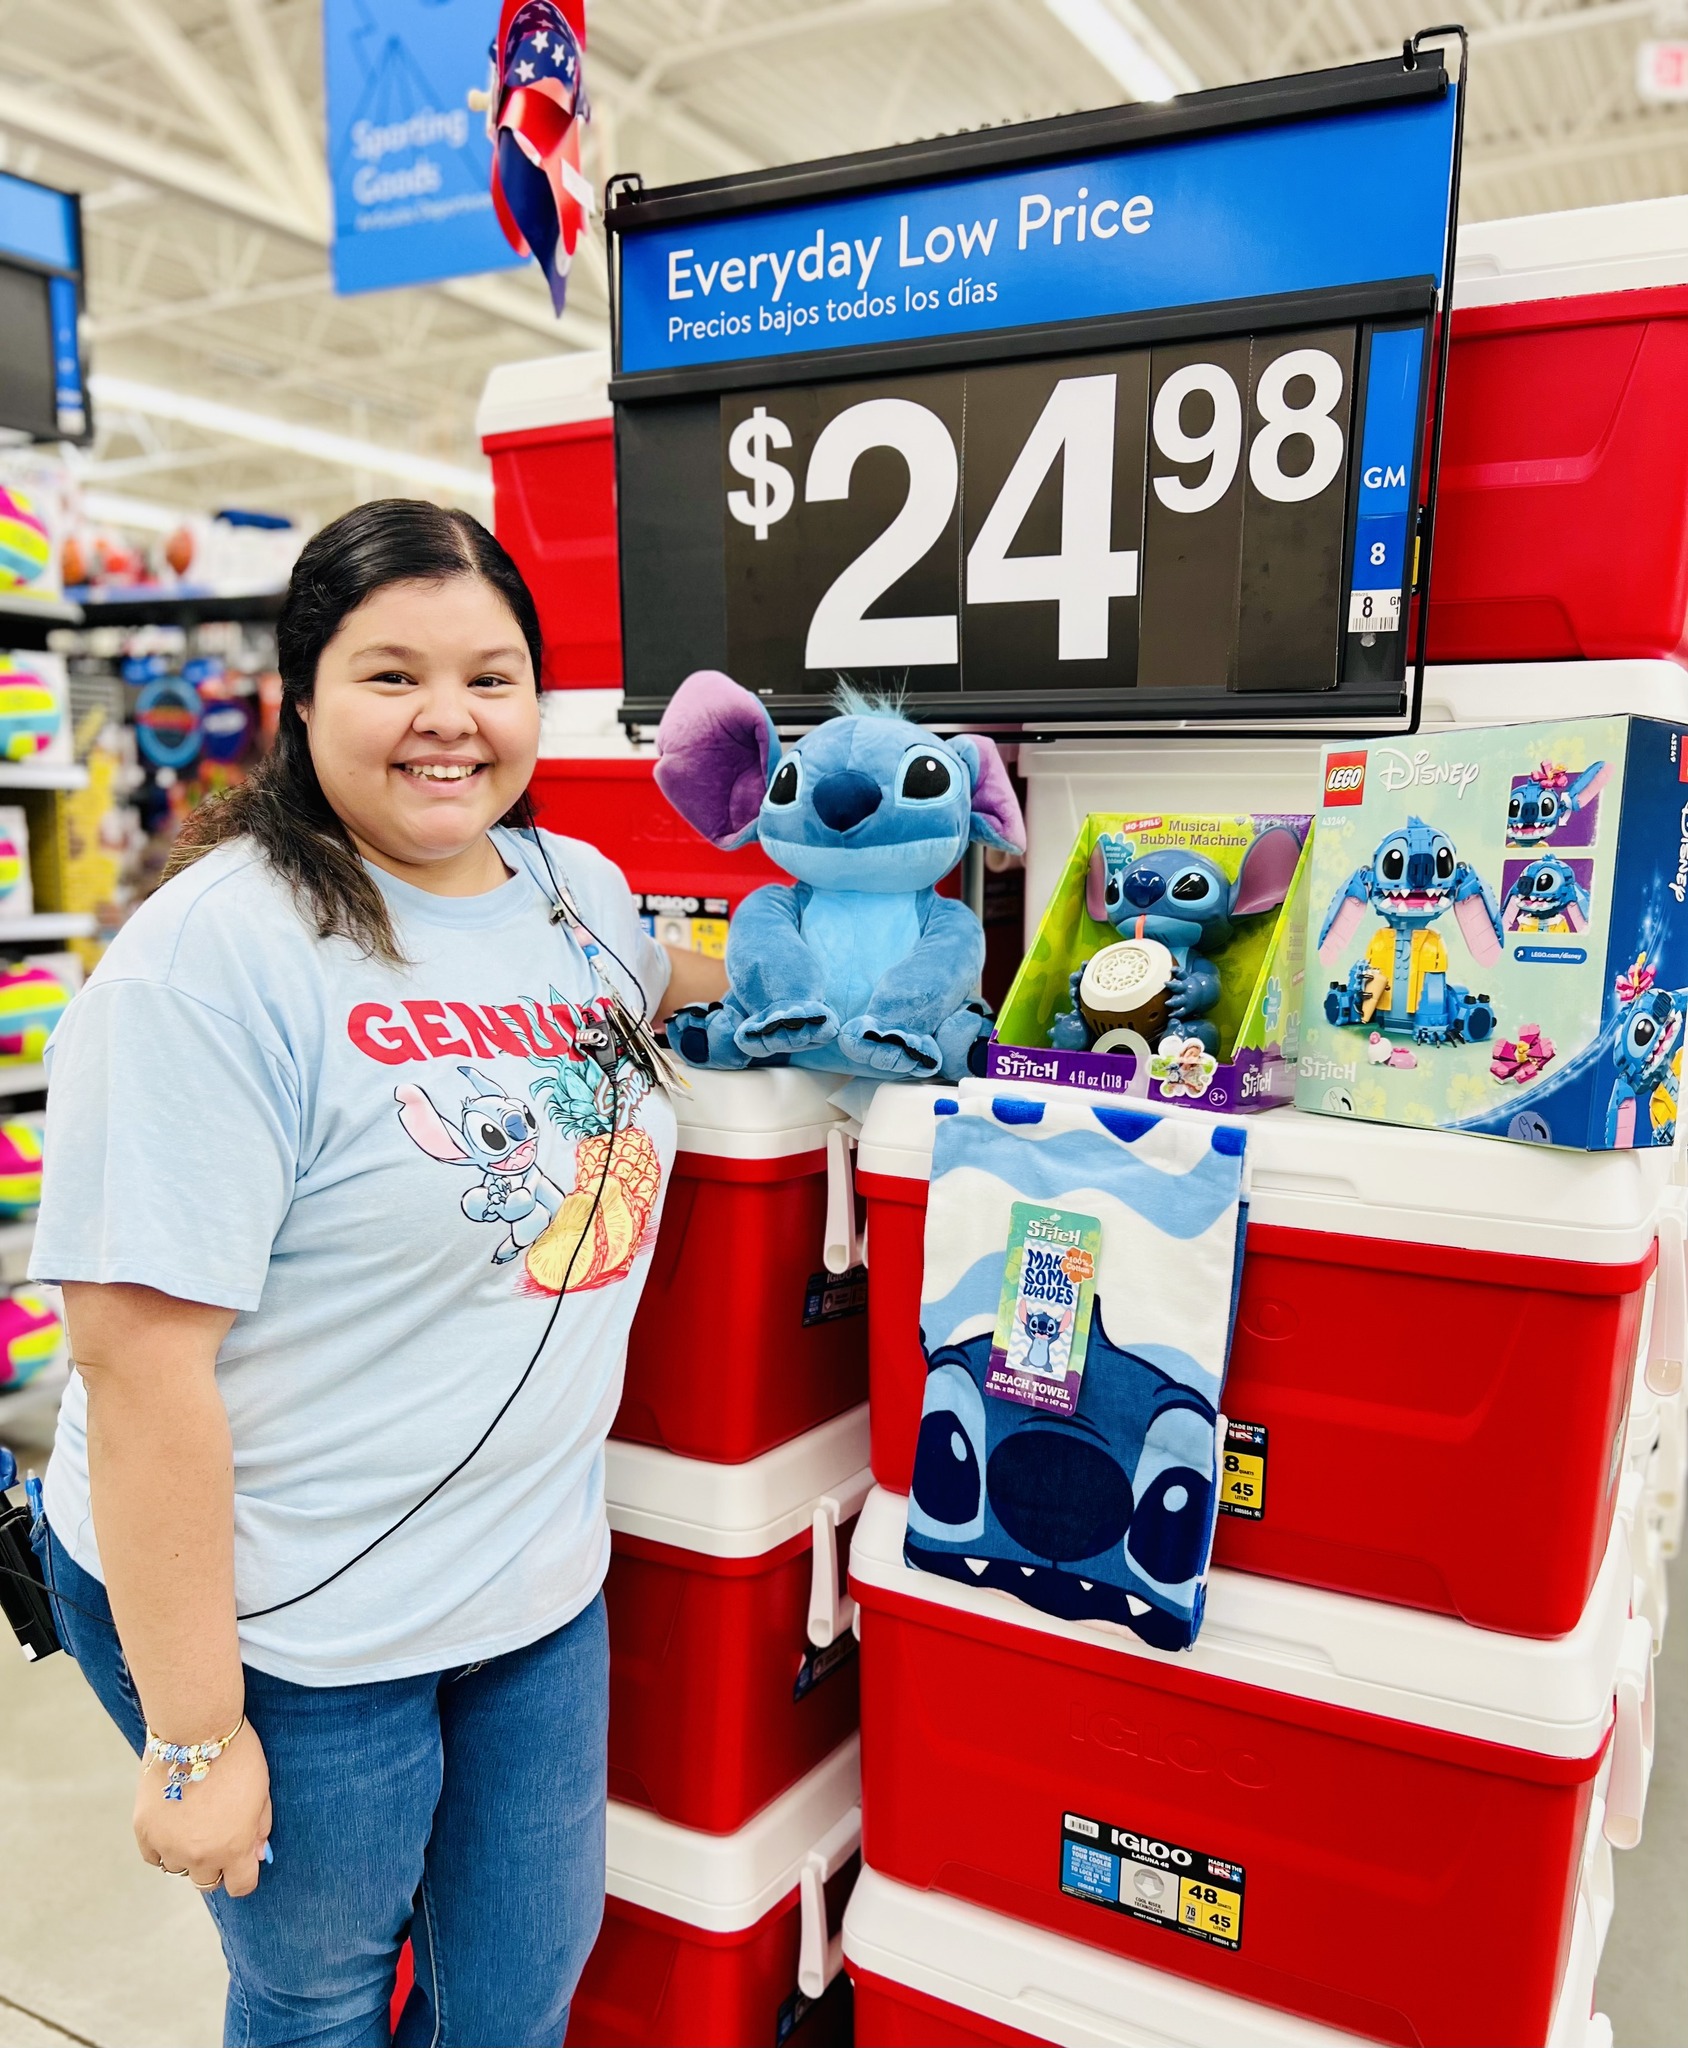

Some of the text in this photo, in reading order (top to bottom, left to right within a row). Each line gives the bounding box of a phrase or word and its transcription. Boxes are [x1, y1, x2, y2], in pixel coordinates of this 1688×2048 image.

[668, 188, 1154, 301] Everyday Low Price
[668, 277, 998, 342] Precios bajos todos los días
[1363, 464, 1406, 489] GM
[1370, 542, 1386, 565] 8
[1362, 596, 1373, 618] 8
[1670, 733, 1678, 763] 43249
[1327, 767, 1363, 790] LEGO
[1169, 820, 1221, 832] Musical
[1322, 816, 1347, 826] 43249
[1140, 834, 1248, 846] Bubble Machine
[1069, 1071, 1076, 1084] 4
[1078, 1070, 1085, 1085] fl
[1087, 1077, 1099, 1086] oz
[1101, 1072, 1122, 1089] (118
[1211, 1092, 1225, 1102] 3+
[1027, 1249, 1065, 1270] MAK
[1069, 1256, 1089, 1267] 100%
[1066, 1262, 1090, 1274] Cotton
[1023, 1282, 1074, 1305] WAVES
[991, 1371, 1071, 1401] BEACH TOWEL
[1229, 1422, 1246, 1431] MADE
[1254, 1426, 1265, 1434] THE
[1231, 1482, 1254, 1497] 45
[1111, 1828, 1192, 1866] IGLOO
[1089, 1856, 1112, 1868] COOLER
[1131, 1852, 1170, 1869] LAGUNA 48
[1208, 1858, 1223, 1868] MADE
[1231, 1864, 1243, 1873] THE
[1084, 1875, 1097, 1884] COLD
[1135, 1896, 1147, 1906] COOL
[1188, 1885, 1218, 1905] 48
[1134, 1901, 1163, 1914] TECHNOLOGY
[1185, 1905, 1196, 1918] 76
[1209, 1913, 1231, 1929] 45
